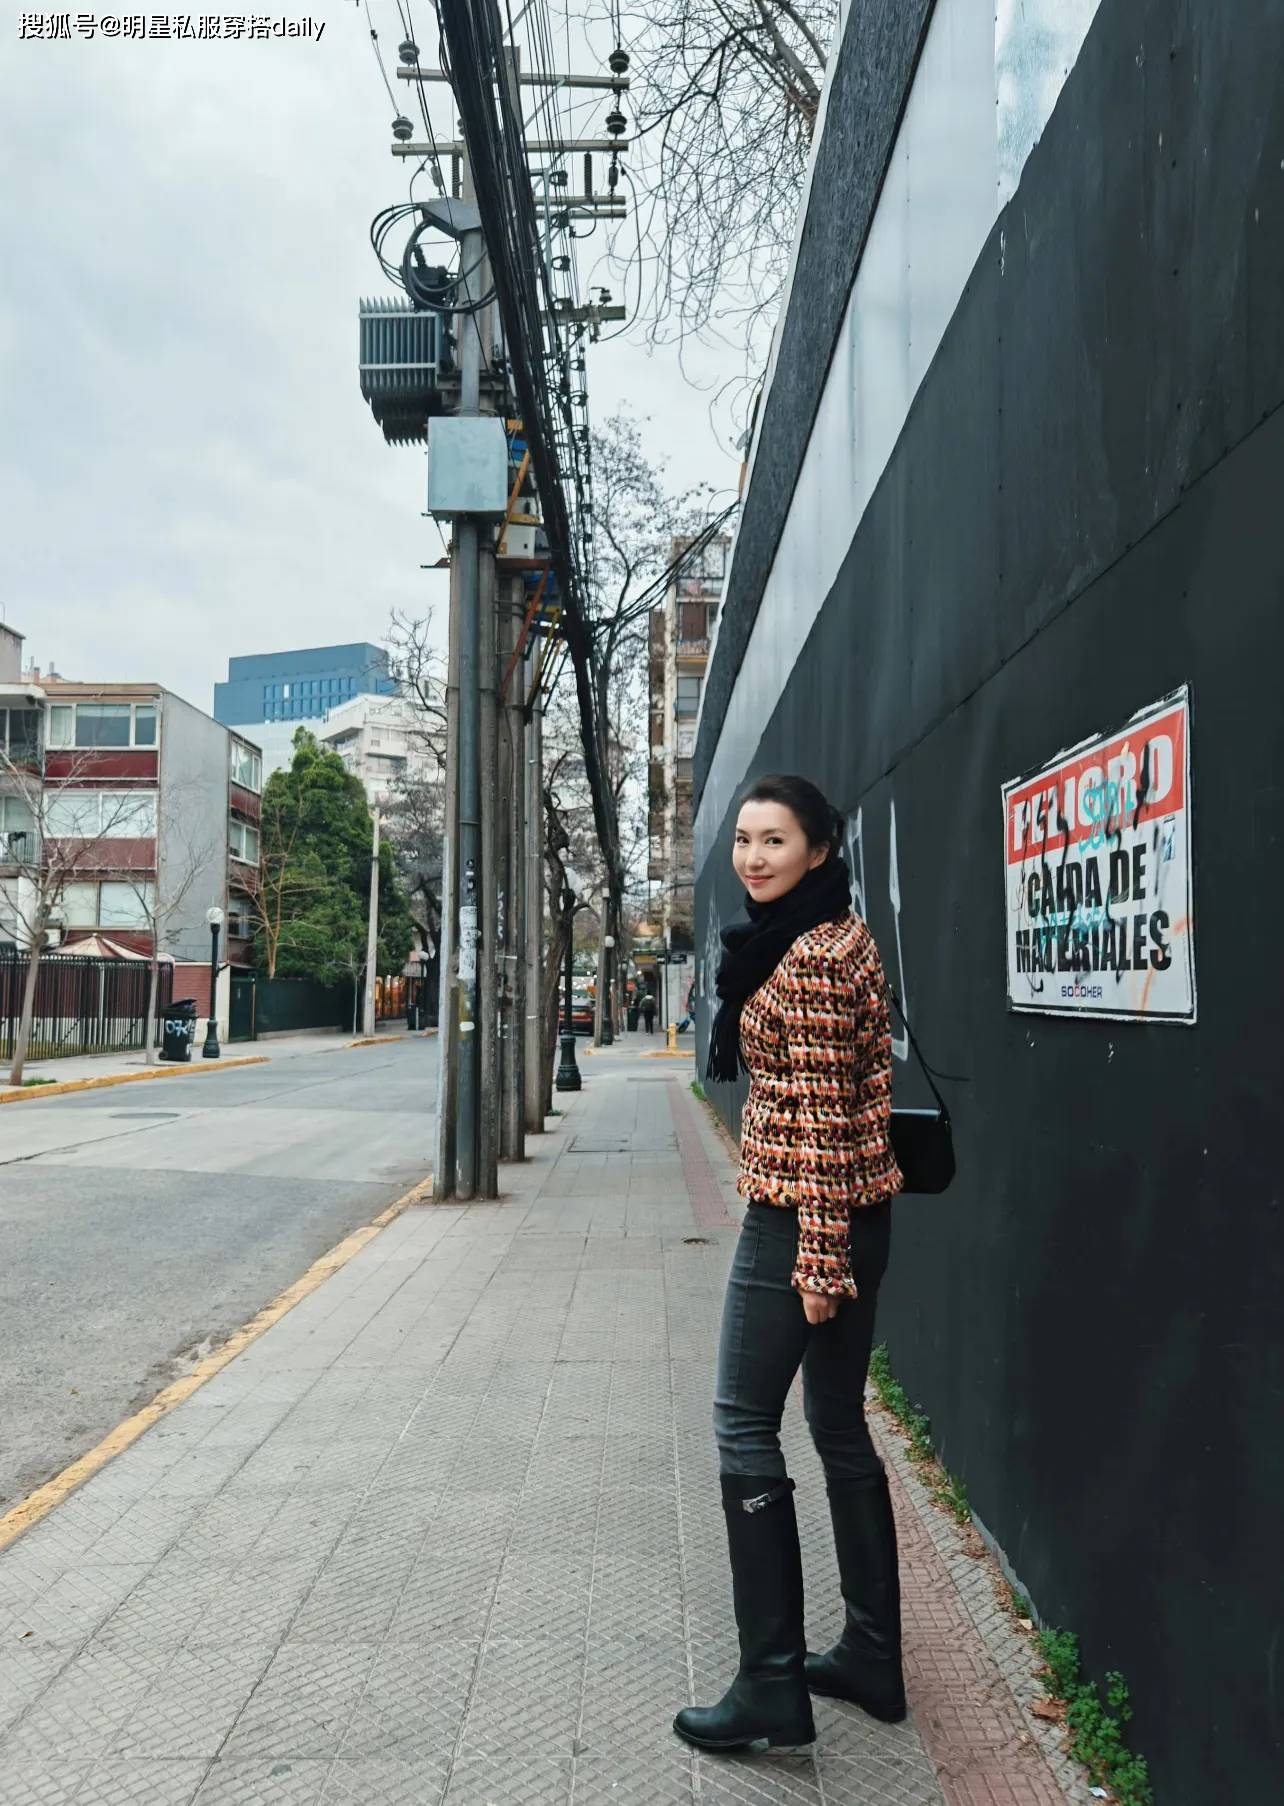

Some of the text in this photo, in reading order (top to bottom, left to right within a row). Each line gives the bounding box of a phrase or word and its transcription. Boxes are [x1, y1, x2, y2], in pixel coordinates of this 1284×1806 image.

[1013, 734, 1173, 851] PELIGRO
[1027, 856, 1102, 918] CAIDA
[1109, 843, 1147, 904] DE
[1016, 910, 1172, 973] MATERIALES
[1061, 985, 1103, 998] SOCOHER
